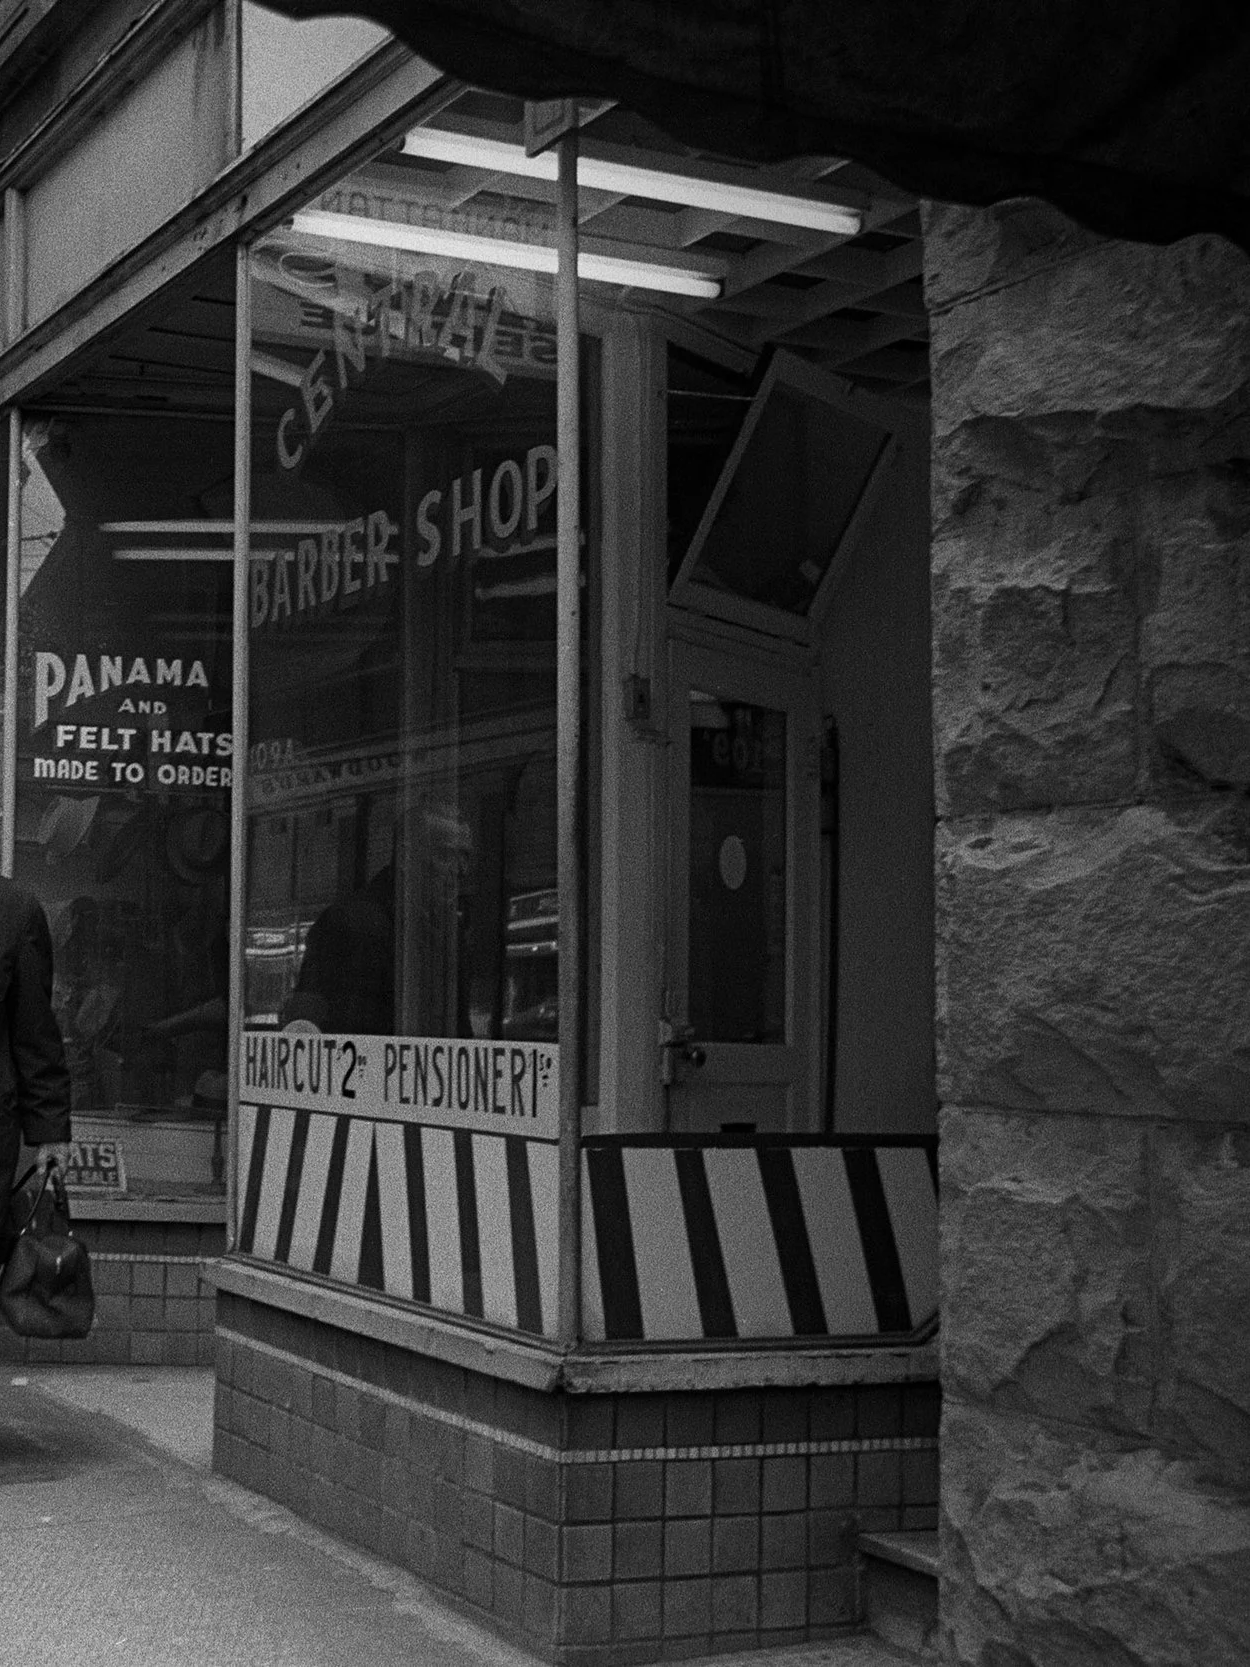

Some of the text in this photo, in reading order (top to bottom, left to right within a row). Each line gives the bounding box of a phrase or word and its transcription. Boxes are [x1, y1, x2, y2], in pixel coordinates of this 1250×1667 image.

[250, 444, 558, 629] BARBER SHOP
[34, 650, 209, 729] PANAMA
[118, 697, 167, 715] AND
[56, 724, 234, 757] FELT HATS
[34, 757, 233, 788] MADE TO ORDER
[246, 1036, 338, 1096] HAIRCUT
[384, 1042, 526, 1116] PENSIONER
[67, 1142, 117, 1169] ATS
